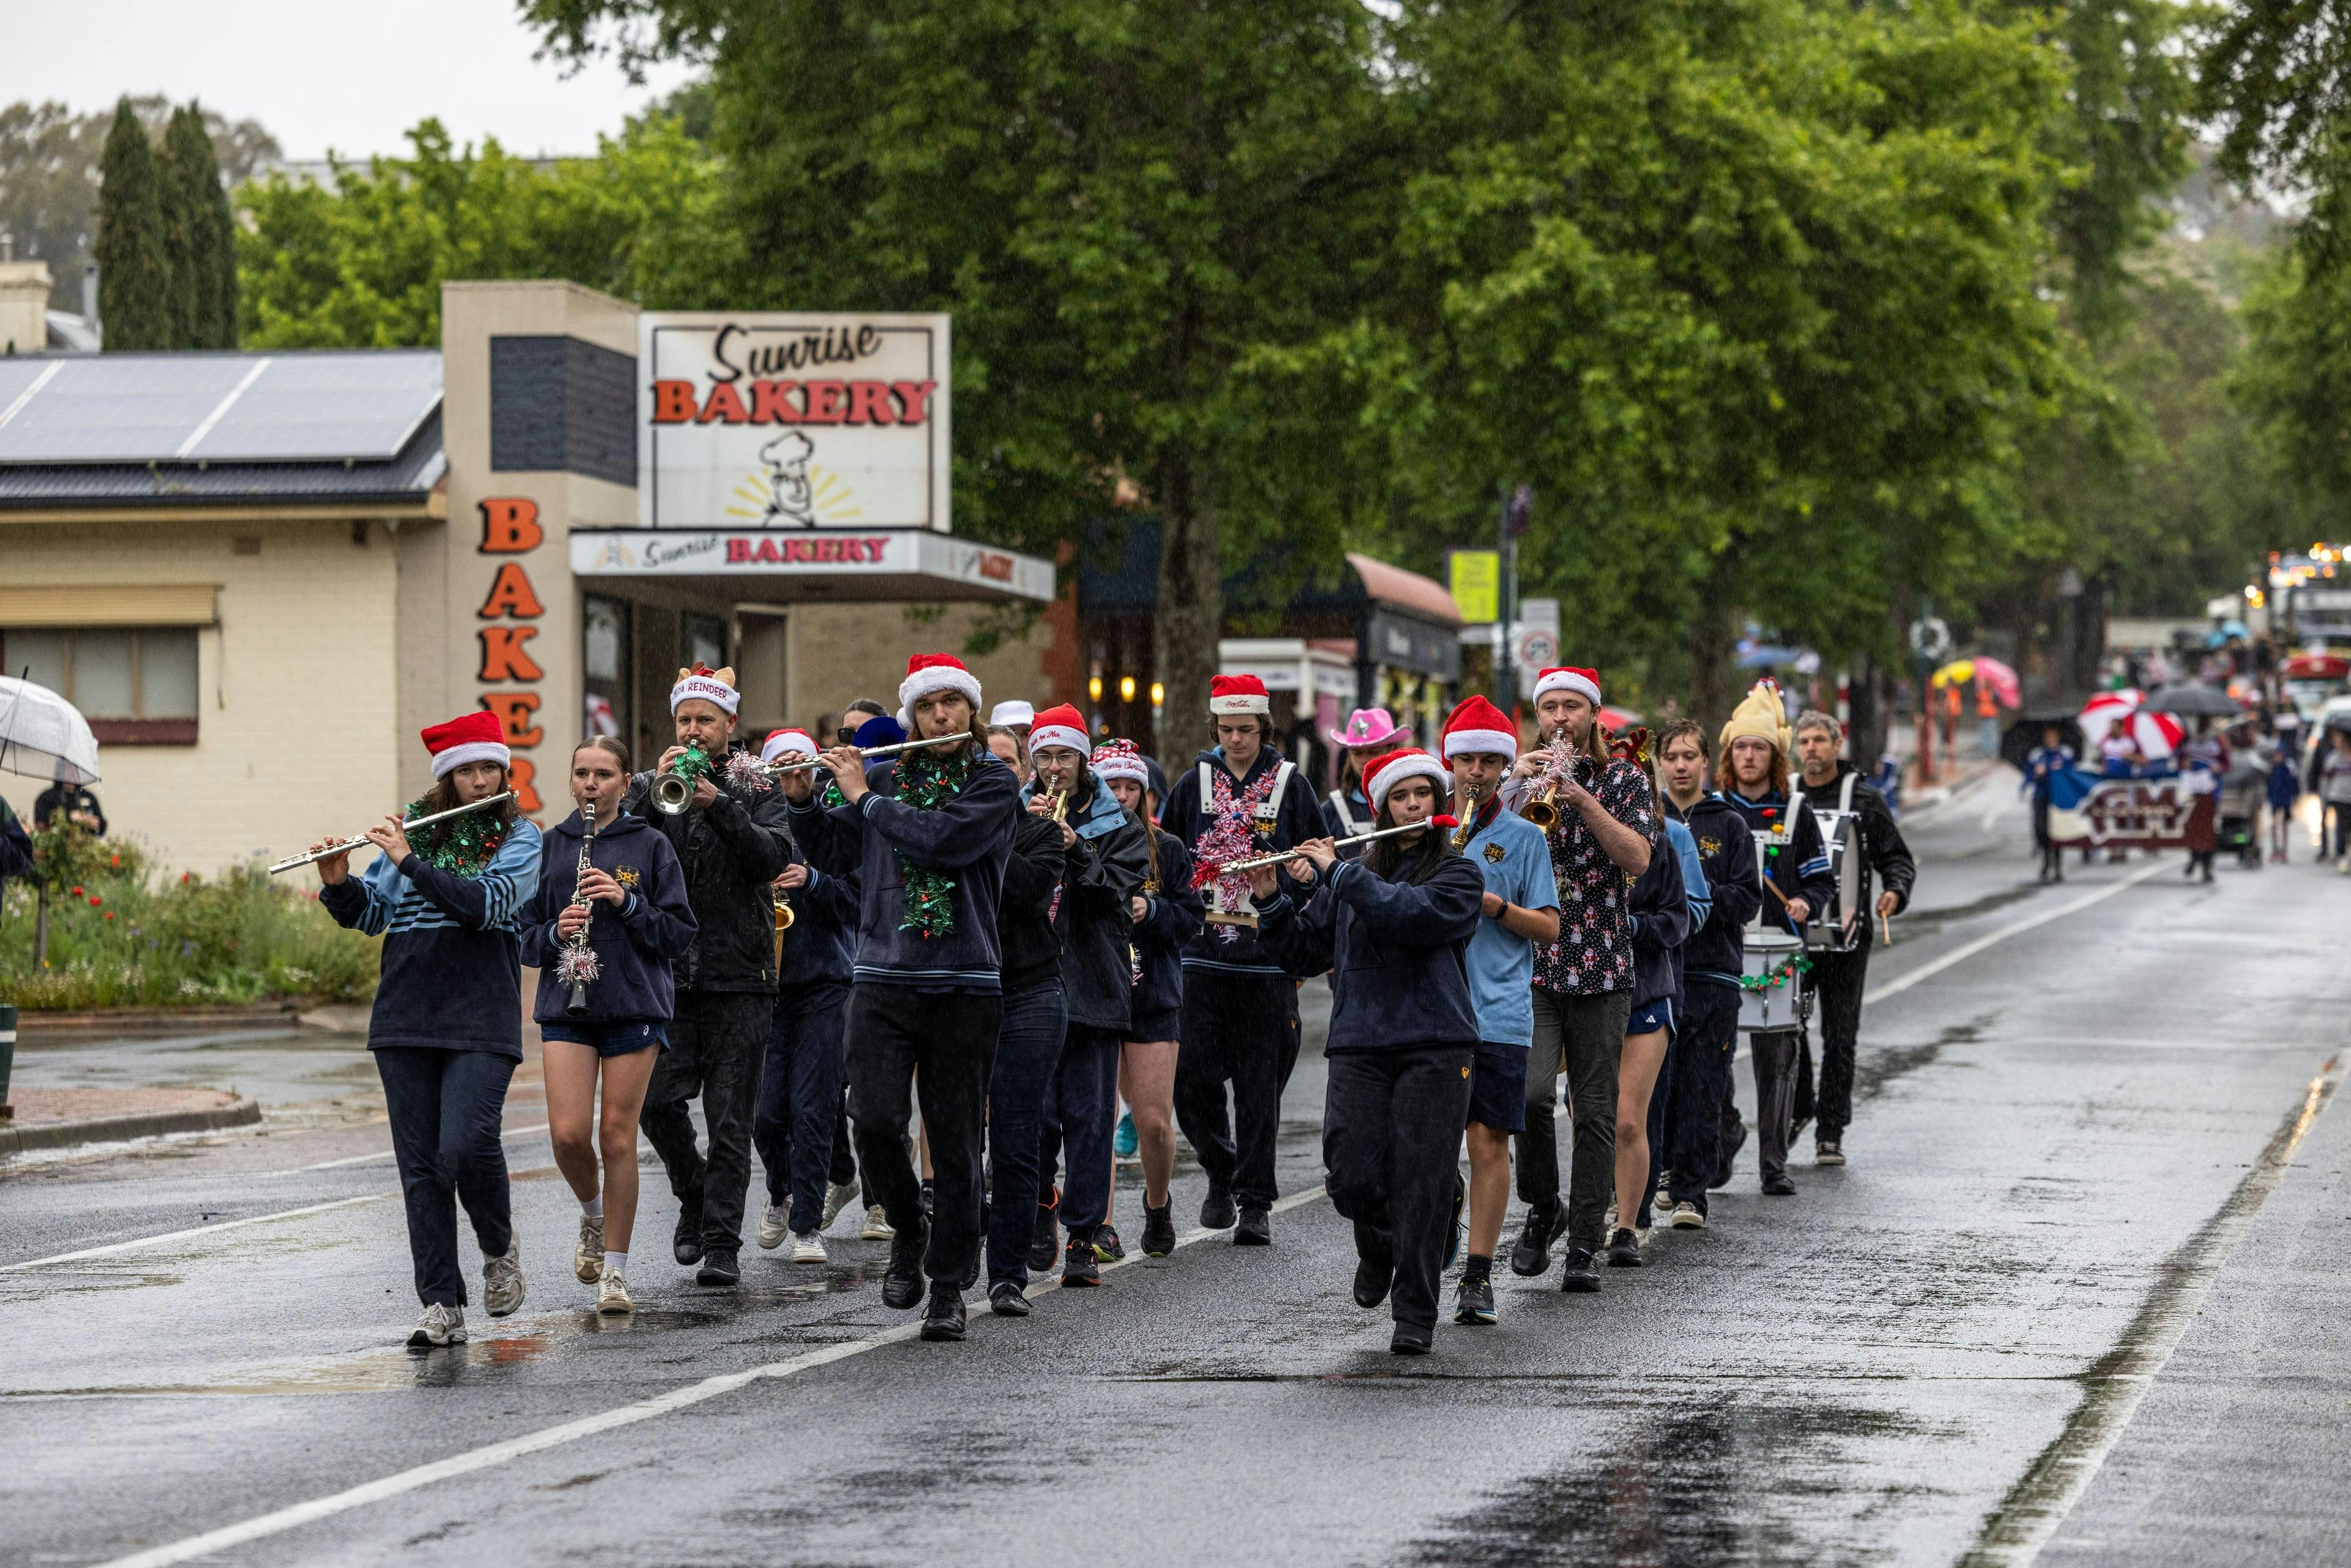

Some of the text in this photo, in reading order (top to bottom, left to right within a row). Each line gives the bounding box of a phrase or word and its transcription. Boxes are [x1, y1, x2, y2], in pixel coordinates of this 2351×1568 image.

[707, 323, 883, 383] Sunrise
[651, 379, 937, 425] BAKERY
[726, 534, 890, 565] BAKERY
[477, 497, 544, 830] BAKER
[688, 682, 727, 701] REINDEER
